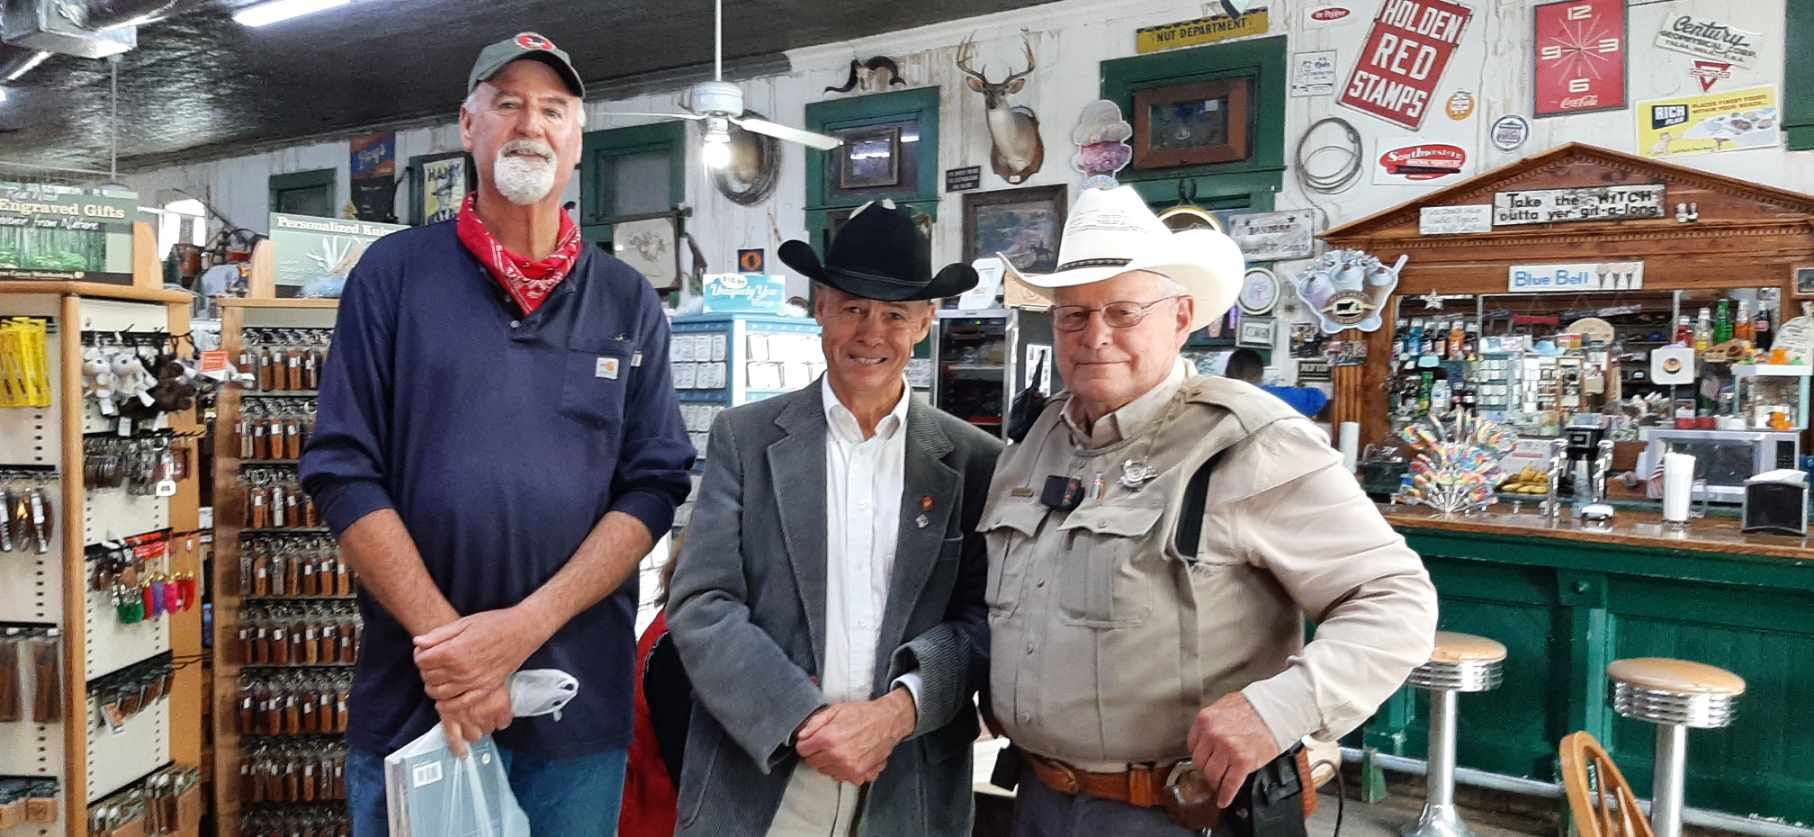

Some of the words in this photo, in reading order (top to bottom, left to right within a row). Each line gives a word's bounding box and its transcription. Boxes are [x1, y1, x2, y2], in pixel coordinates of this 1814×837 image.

[1382, 0, 1464, 43] HOLDEN
[1567, 5, 1592, 20] 12
[1156, 29, 1176, 42] NUT
[1180, 16, 1247, 39] DEPARTMENT
[1672, 15, 1751, 46] Century
[1371, 32, 1438, 81] RED
[1541, 45, 1561, 60] 9
[1599, 38, 1618, 53] 3
[1348, 70, 1428, 118] STAMPS
[1569, 78, 1590, 93] 6
[1654, 106, 1686, 121] RICH
[0, 198, 79, 216] Engraved
[84, 203, 126, 219] Gifts
[1507, 193, 1542, 208] Take
[1555, 195, 1579, 206] the
[277, 216, 359, 233] Personalized
[1500, 209, 1539, 222] outta
[1548, 209, 1575, 220] yer
[1515, 271, 1551, 287] Blue
[1555, 269, 1589, 286] Bell
